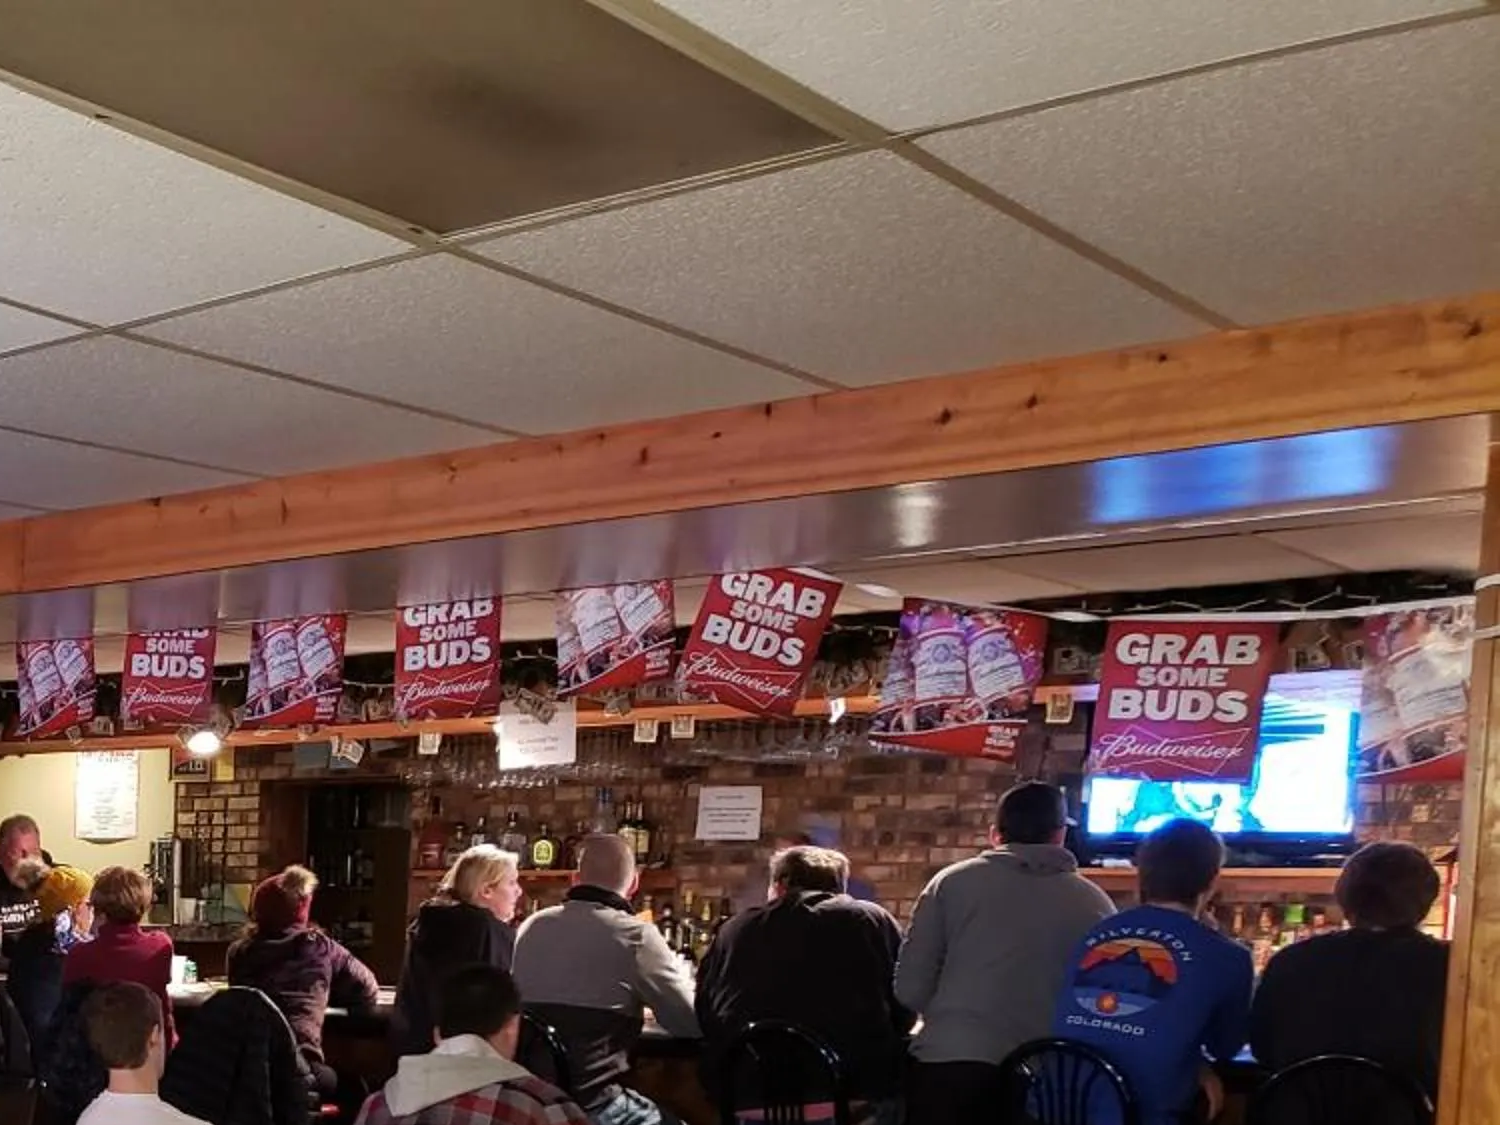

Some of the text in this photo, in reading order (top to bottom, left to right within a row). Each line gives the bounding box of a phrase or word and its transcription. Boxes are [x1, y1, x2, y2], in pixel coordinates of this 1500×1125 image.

[721, 573, 827, 619] GRAB
[404, 599, 494, 627] GRAB
[730, 600, 799, 634] SOME
[146, 637, 195, 654] SOME
[419, 619, 477, 643] SOME
[701, 614, 806, 666] BUDS
[404, 637, 492, 671] BUDS
[1116, 633, 1261, 665] GRAB
[130, 654, 205, 679] BUDS
[685, 652, 792, 697] Budweiser
[1135, 667, 1229, 688] SOME
[126, 687, 204, 707] Budweiser
[401, 675, 491, 704] Budweiser
[1107, 689, 1248, 723] BUDS
[1100, 733, 1245, 769] Budweiser
[1066, 1014, 1146, 1037] COLORADO
